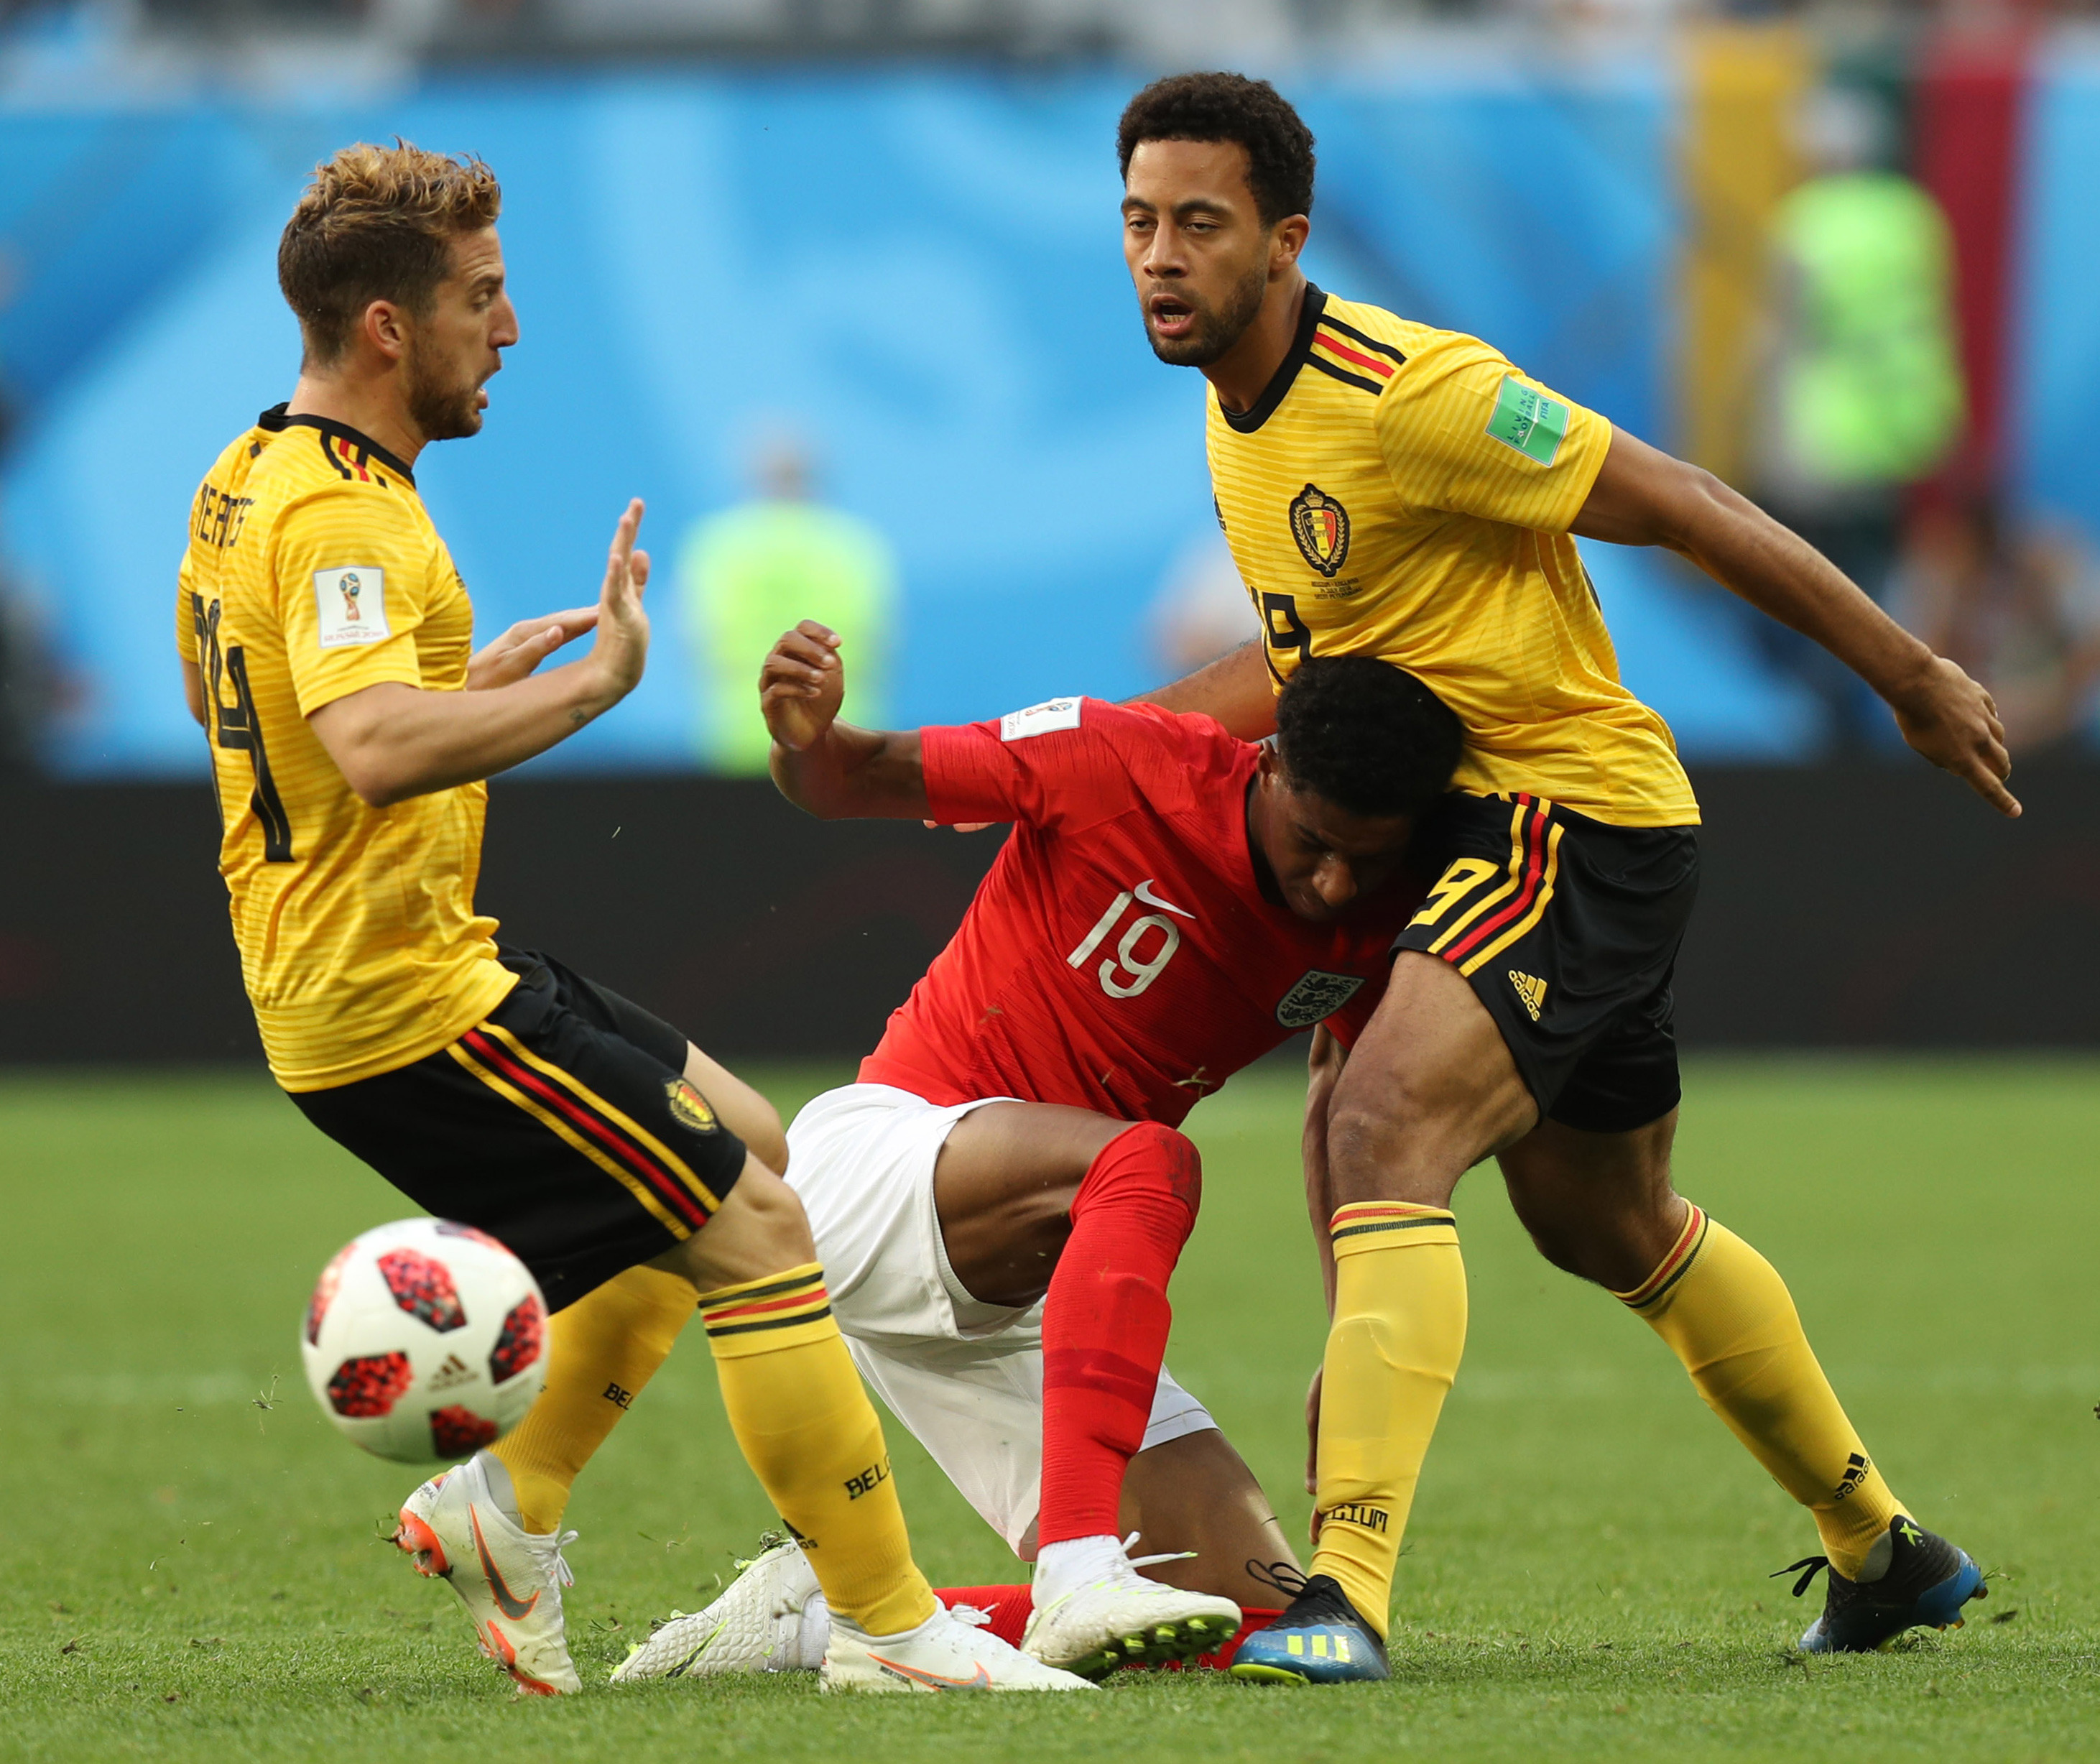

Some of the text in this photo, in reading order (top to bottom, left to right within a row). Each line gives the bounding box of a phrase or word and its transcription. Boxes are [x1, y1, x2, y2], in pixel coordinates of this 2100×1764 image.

[1507, 389, 1528, 440] LIVING
[1540, 402, 1550, 420] FIFA
[1066, 890, 1180, 998] 19
[1508, 969, 1541, 1022] adidas
